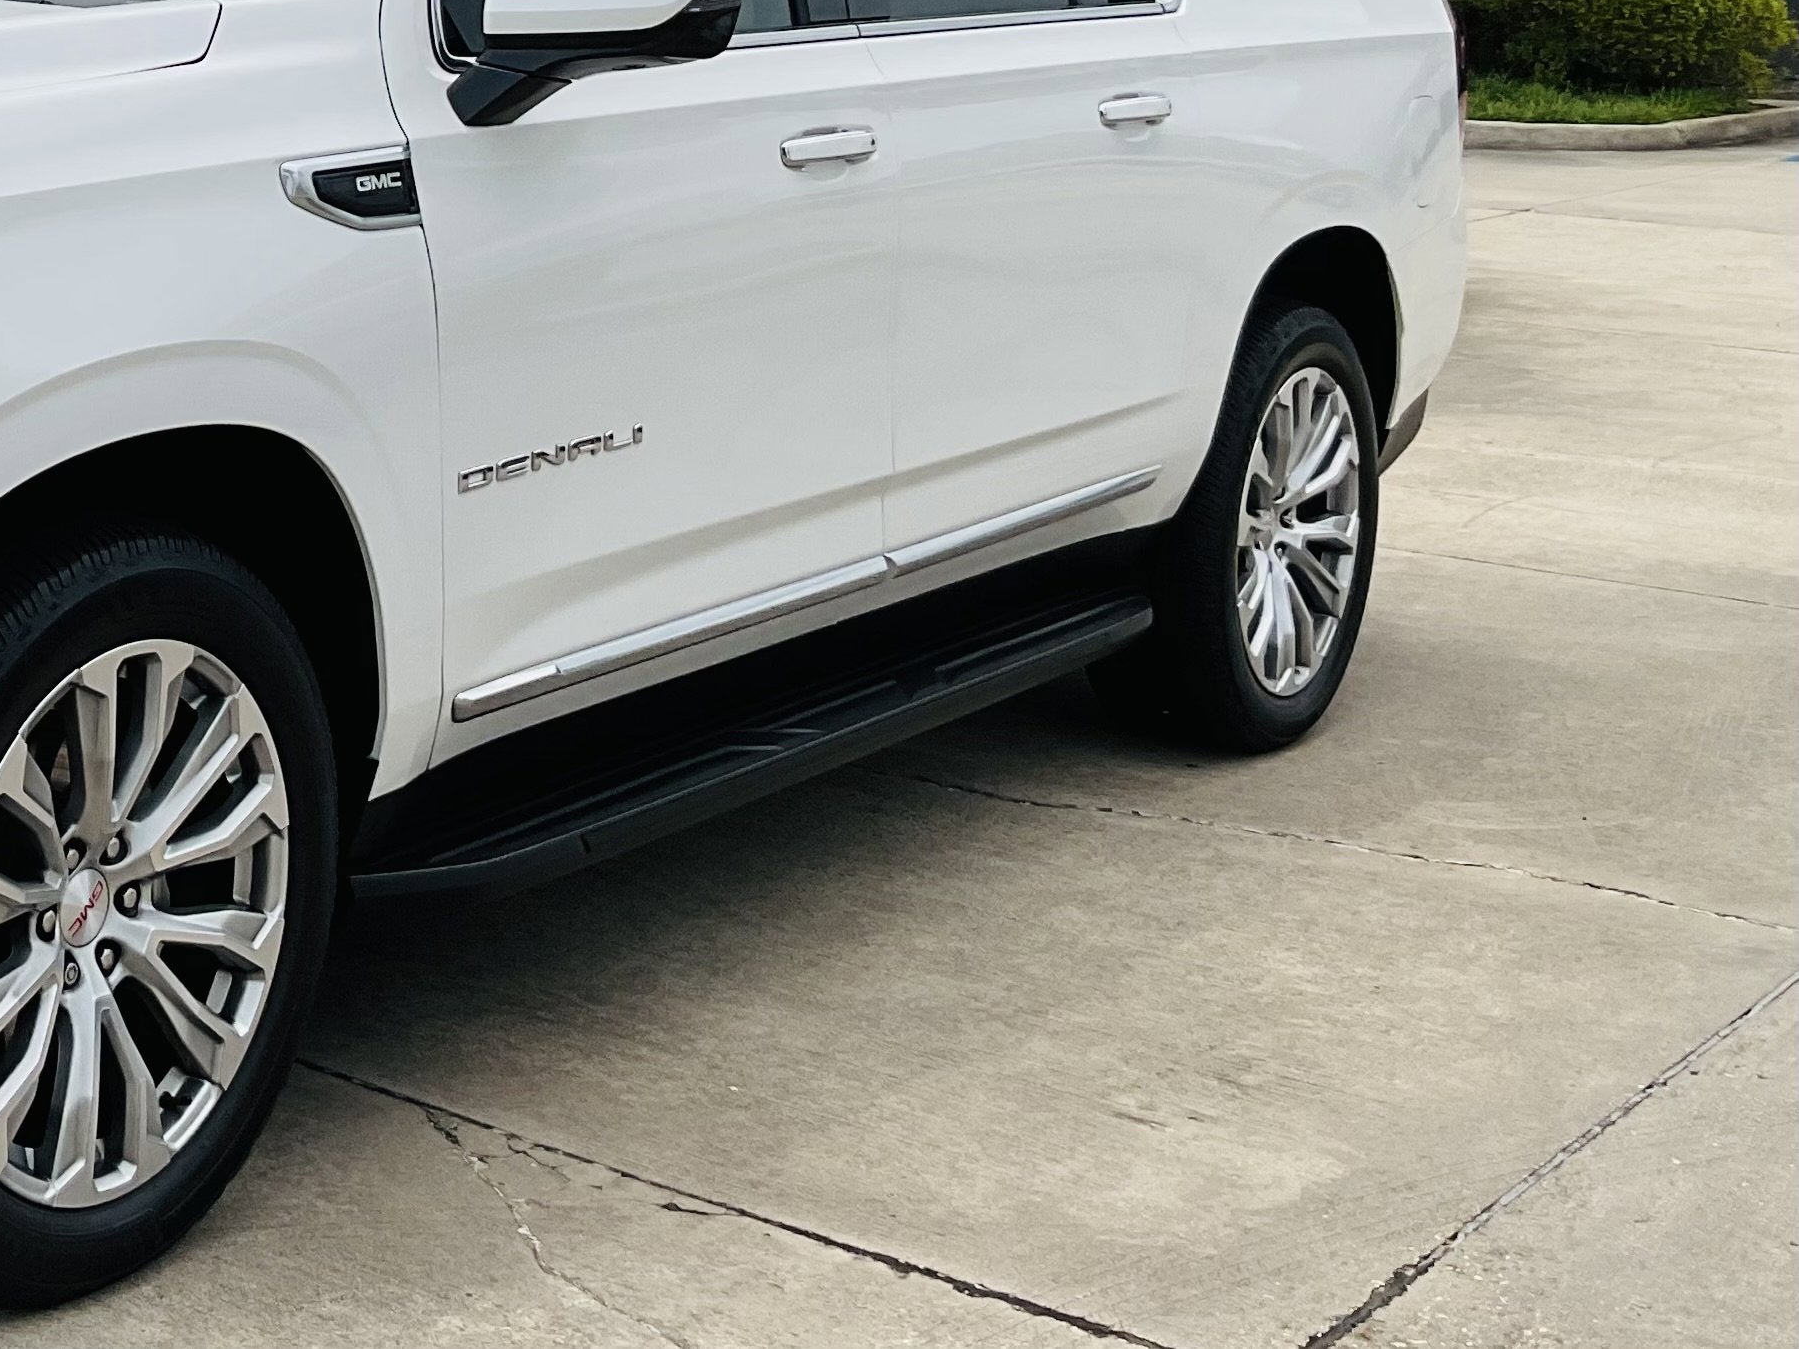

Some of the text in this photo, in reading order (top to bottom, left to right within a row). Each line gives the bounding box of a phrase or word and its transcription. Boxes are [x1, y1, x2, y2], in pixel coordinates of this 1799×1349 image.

[355, 171, 402, 192] GMC
[458, 420, 643, 494] DENALI
[68, 880, 104, 938] GMC
